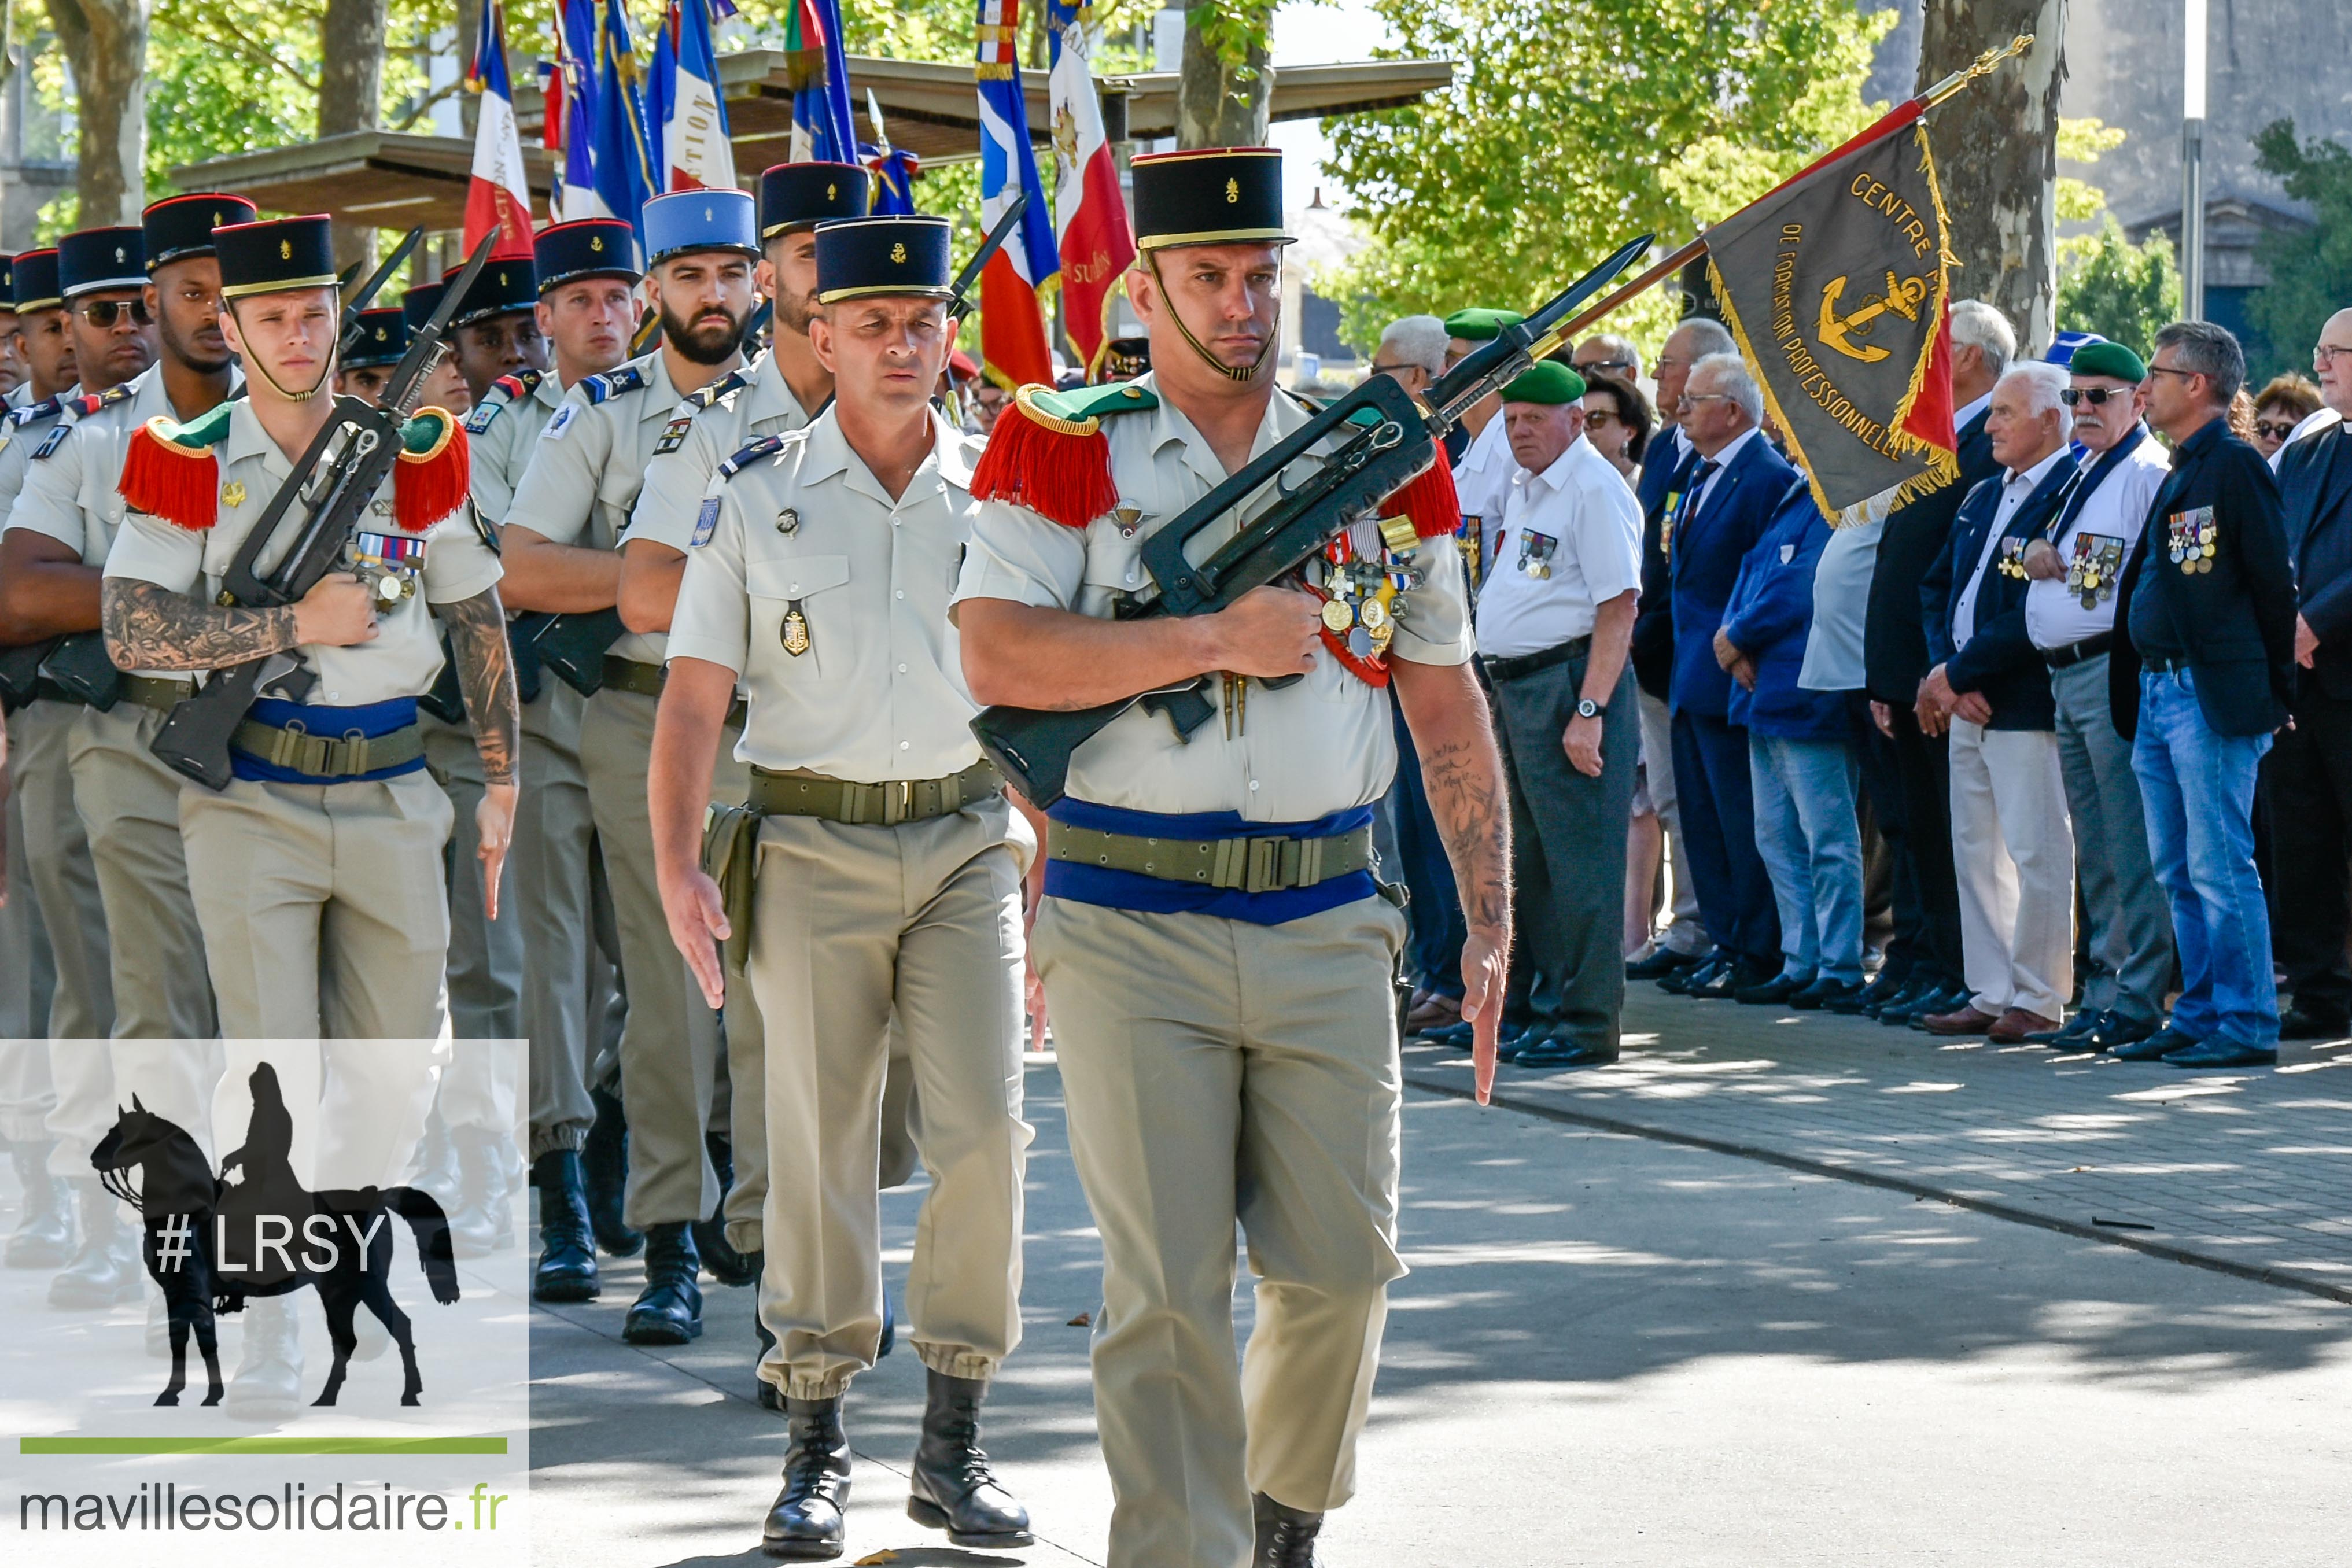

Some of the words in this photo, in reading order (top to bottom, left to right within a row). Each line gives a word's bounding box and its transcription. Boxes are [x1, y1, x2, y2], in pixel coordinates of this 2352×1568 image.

[493, 160, 515, 241] SECTION
[1779, 224, 1803, 245] DE
[1851, 172, 1931, 260] CENTRE
[1772, 252, 1796, 341] FORMATION
